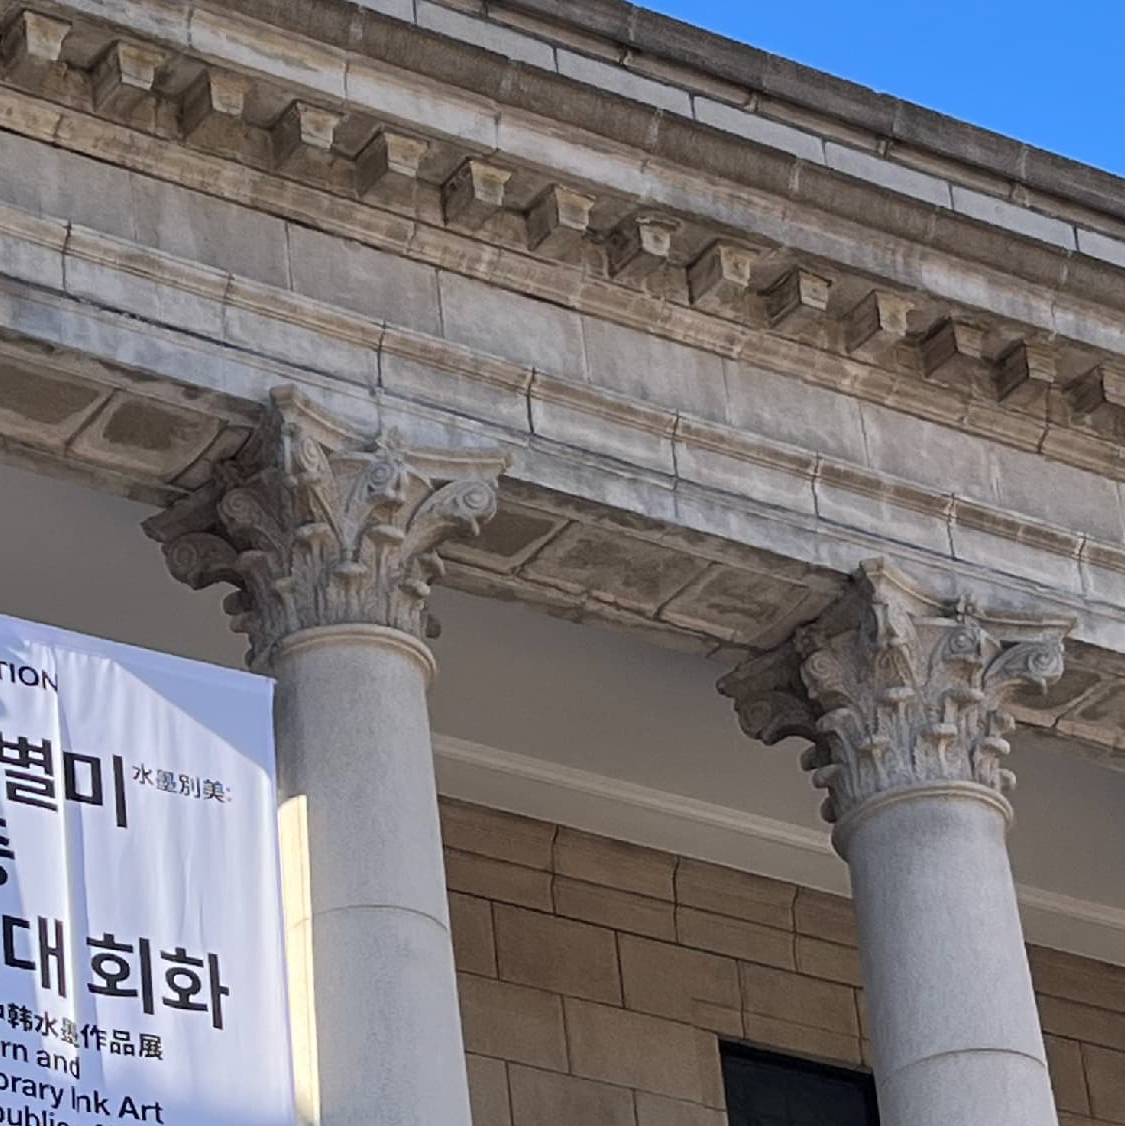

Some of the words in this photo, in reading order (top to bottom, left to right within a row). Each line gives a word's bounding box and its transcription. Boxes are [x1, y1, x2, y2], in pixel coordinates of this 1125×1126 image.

[85, 932, 230, 1030] 회화
[36, 1049, 80, 1079] and
[71, 1086, 111, 1117] Ink
[118, 1095, 165, 1125] Art
